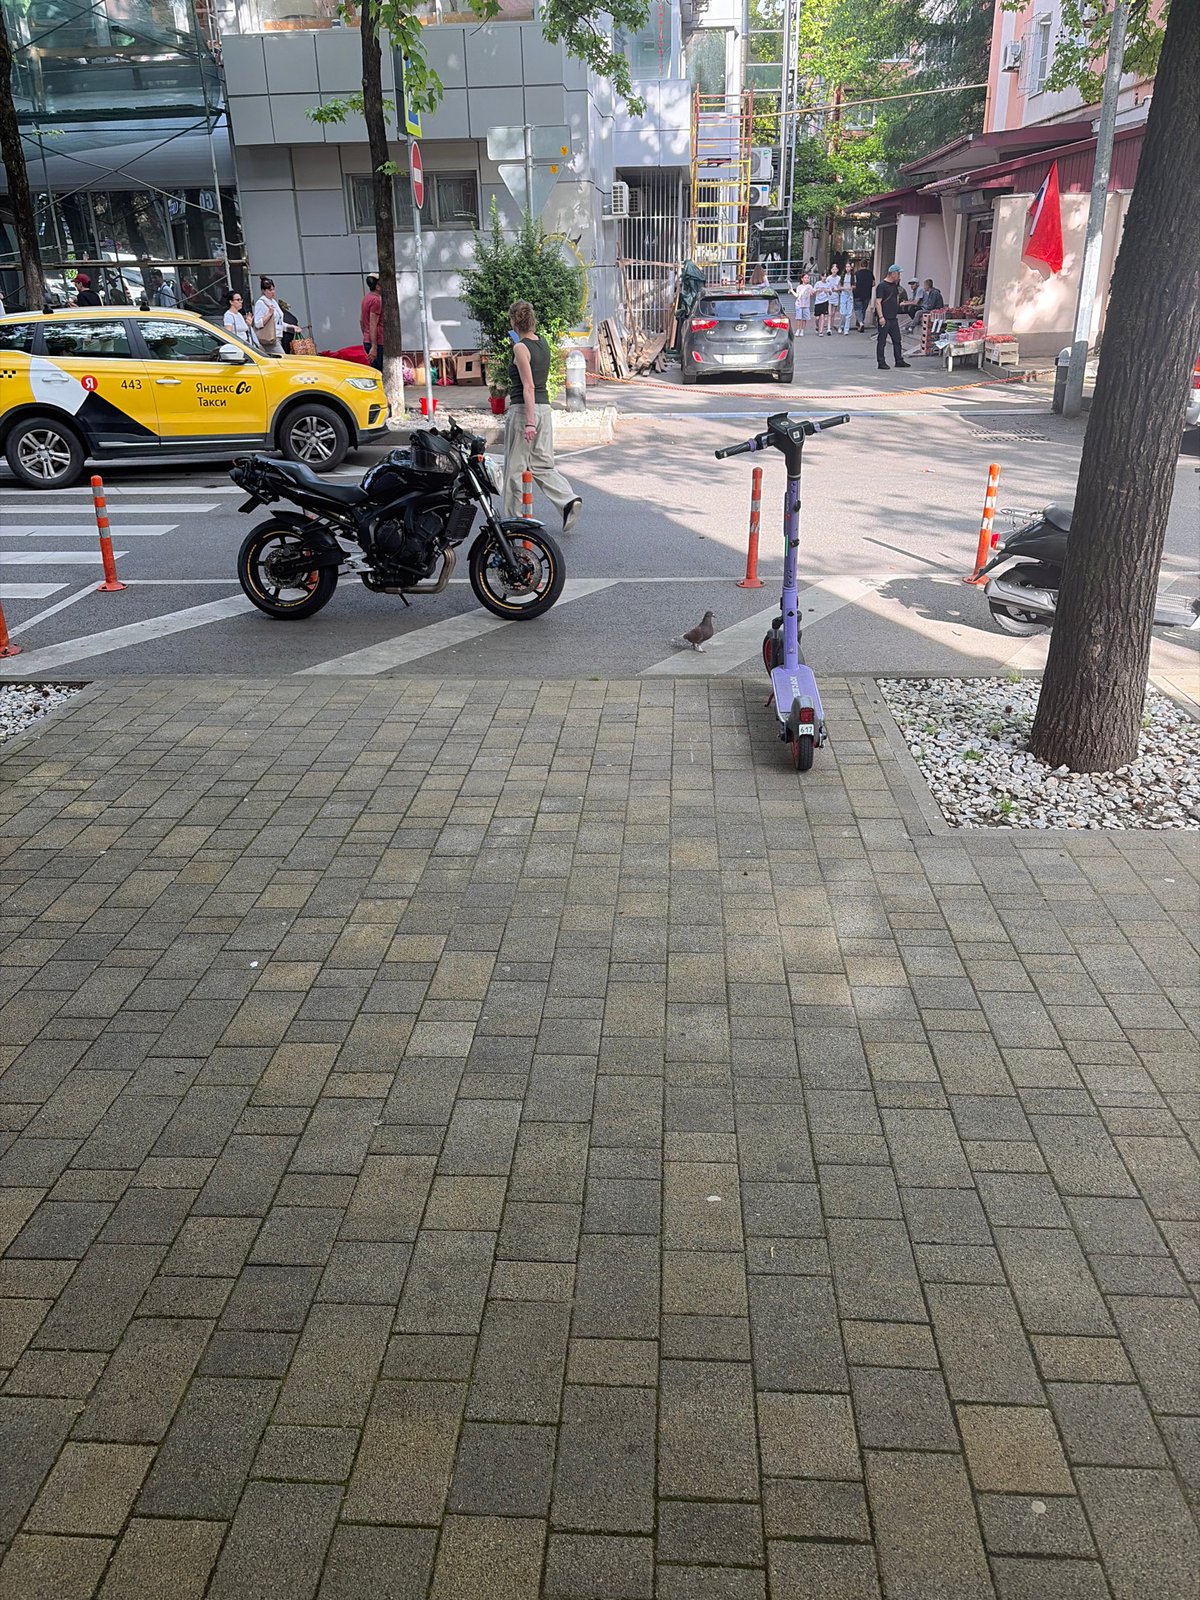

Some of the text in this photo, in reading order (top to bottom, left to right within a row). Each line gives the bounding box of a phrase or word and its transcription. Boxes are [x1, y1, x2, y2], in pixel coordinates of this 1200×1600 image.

[86, 377, 94, 389] Я
[121, 379, 142, 390] 443
[196, 381, 252, 395] Яндекс Go
[197, 396, 227, 407] Такси
